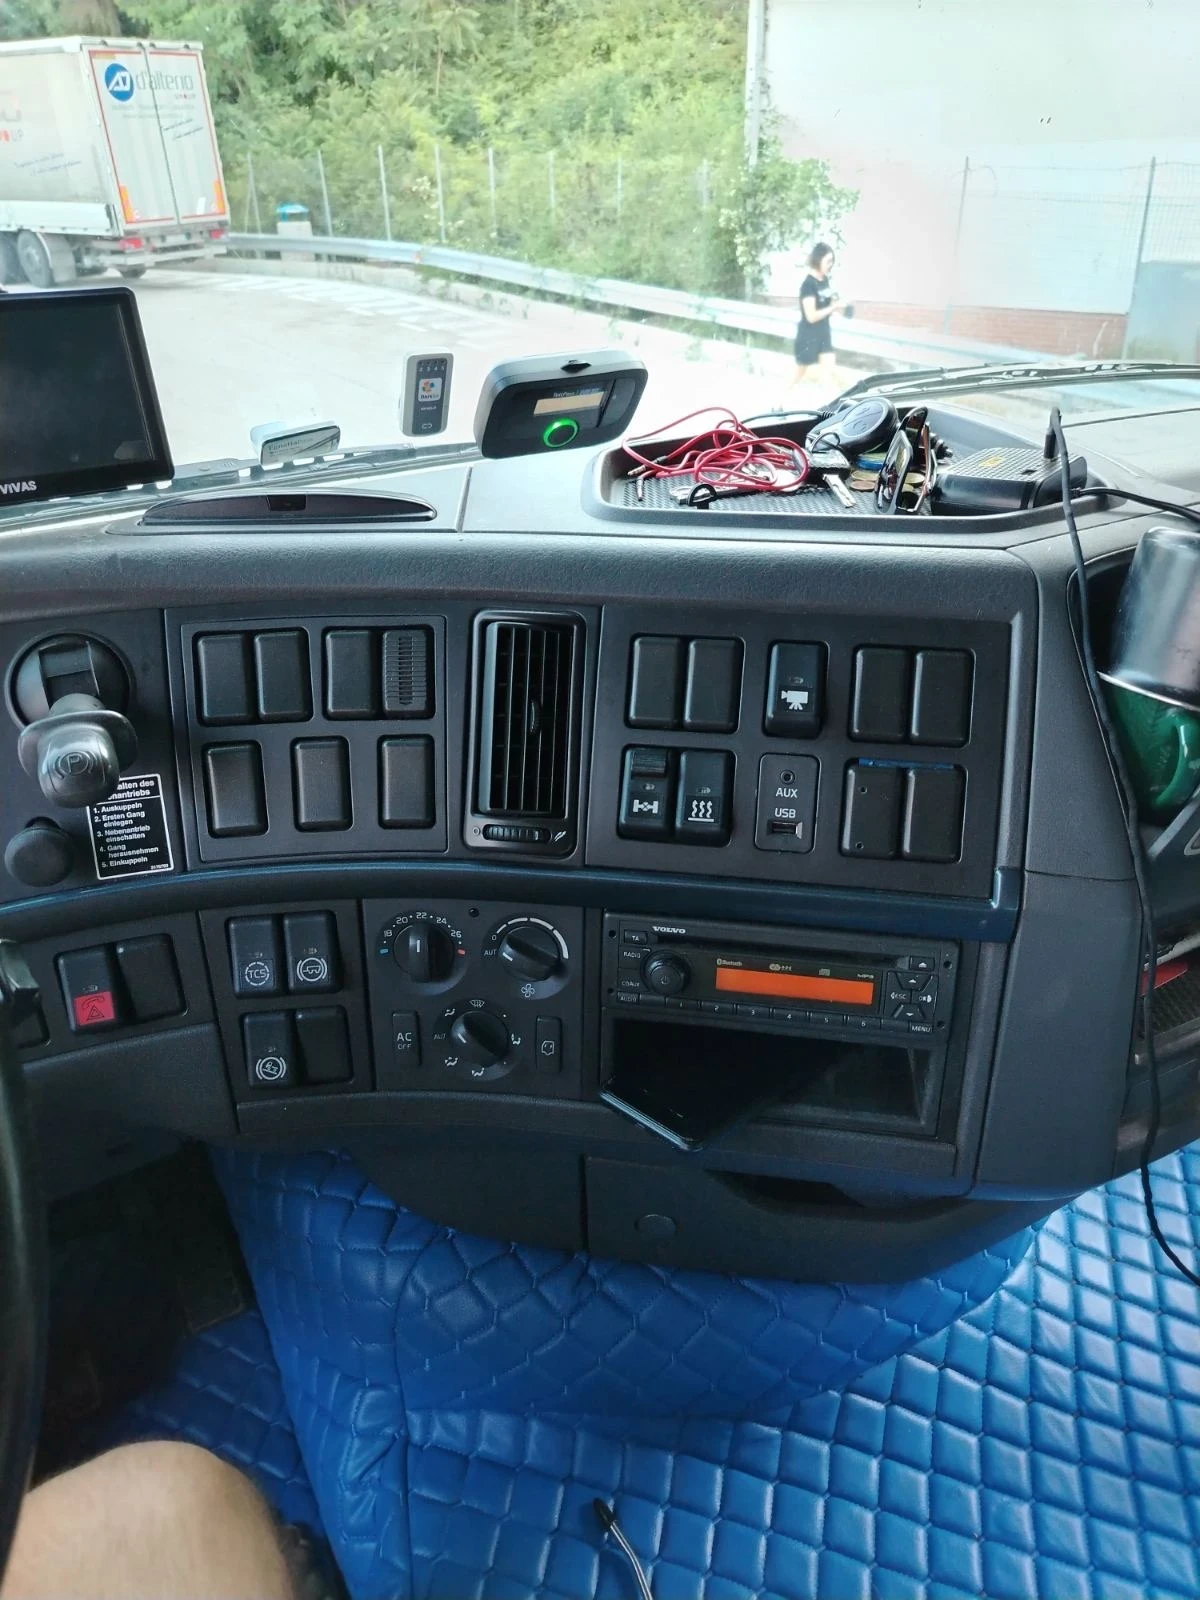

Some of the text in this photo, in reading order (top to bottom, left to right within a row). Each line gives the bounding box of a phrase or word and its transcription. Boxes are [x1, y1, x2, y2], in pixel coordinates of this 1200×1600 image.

[0, 480, 37, 494] VIVAS
[116, 780, 155, 790] alten des
[775, 787, 798, 798] AUX
[101, 802, 142, 814] Auskuppeln
[774, 808, 796, 818] USB
[102, 813, 125, 822] Ersten
[104, 819, 133, 828] einlegen
[105, 825, 151, 836] Nebenantrieb
[106, 833, 145, 843] einschalten
[107, 844, 126, 852] Gang
[108, 846, 159, 858] herausnehmen
[110, 856, 148, 866] Einkuppeln
[450, 930, 462, 938] 26
[652, 926, 686, 934] VOLVO
[248, 969, 267, 979] TCS
[396, 1032, 412, 1041] AC
